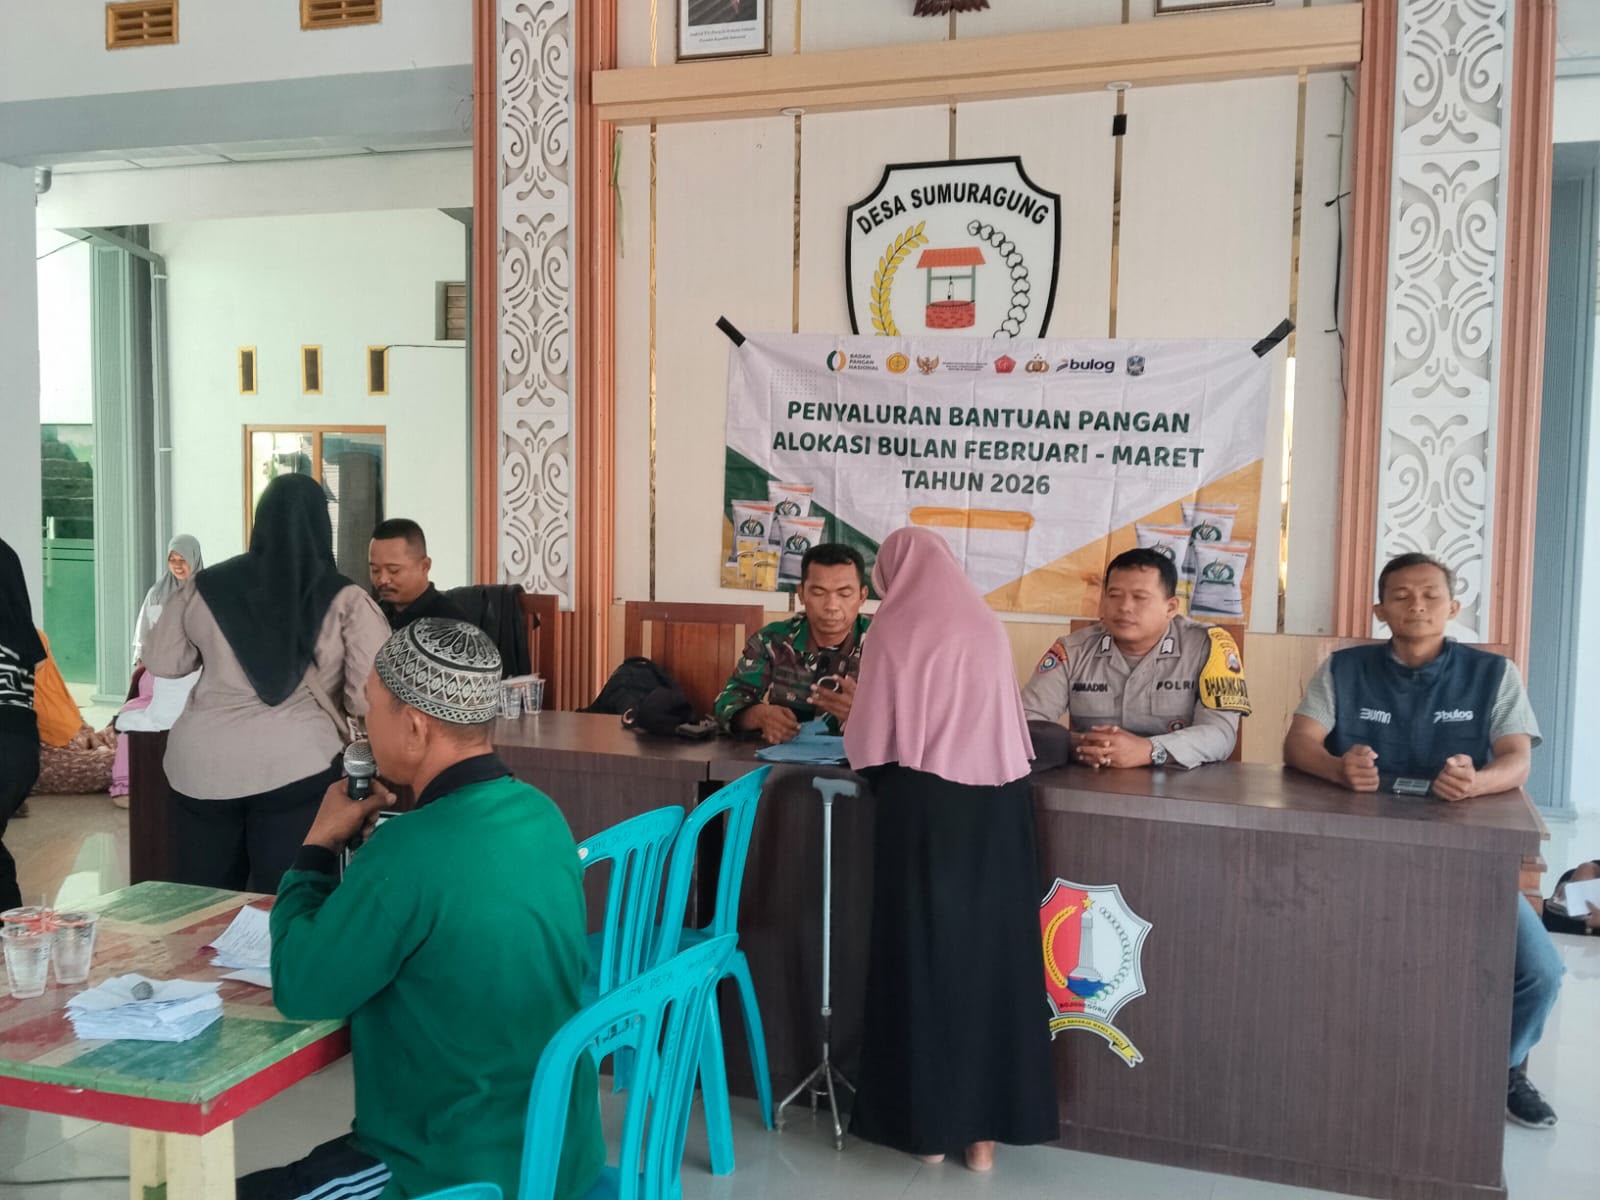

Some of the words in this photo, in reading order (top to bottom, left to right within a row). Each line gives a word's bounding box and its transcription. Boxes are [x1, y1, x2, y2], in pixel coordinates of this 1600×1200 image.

[856, 195, 907, 235] DESA
[910, 182, 1049, 225] SUMURAGUNG
[1069, 358, 1115, 374] bulog
[787, 400, 941, 427] PENYALURAN
[949, 406, 1071, 430] BANTUAN
[1078, 410, 1190, 433] PANGAN
[772, 431, 871, 456] ALOKASI
[878, 436, 957, 459] BULAN
[964, 440, 1088, 464] FEBRUARI
[1112, 445, 1205, 468] MARET
[901, 469, 984, 492] TAHUN
[990, 473, 1050, 495] 2026
[1156, 680, 1195, 691] POLRI
[1442, 708, 1474, 722] bulog
